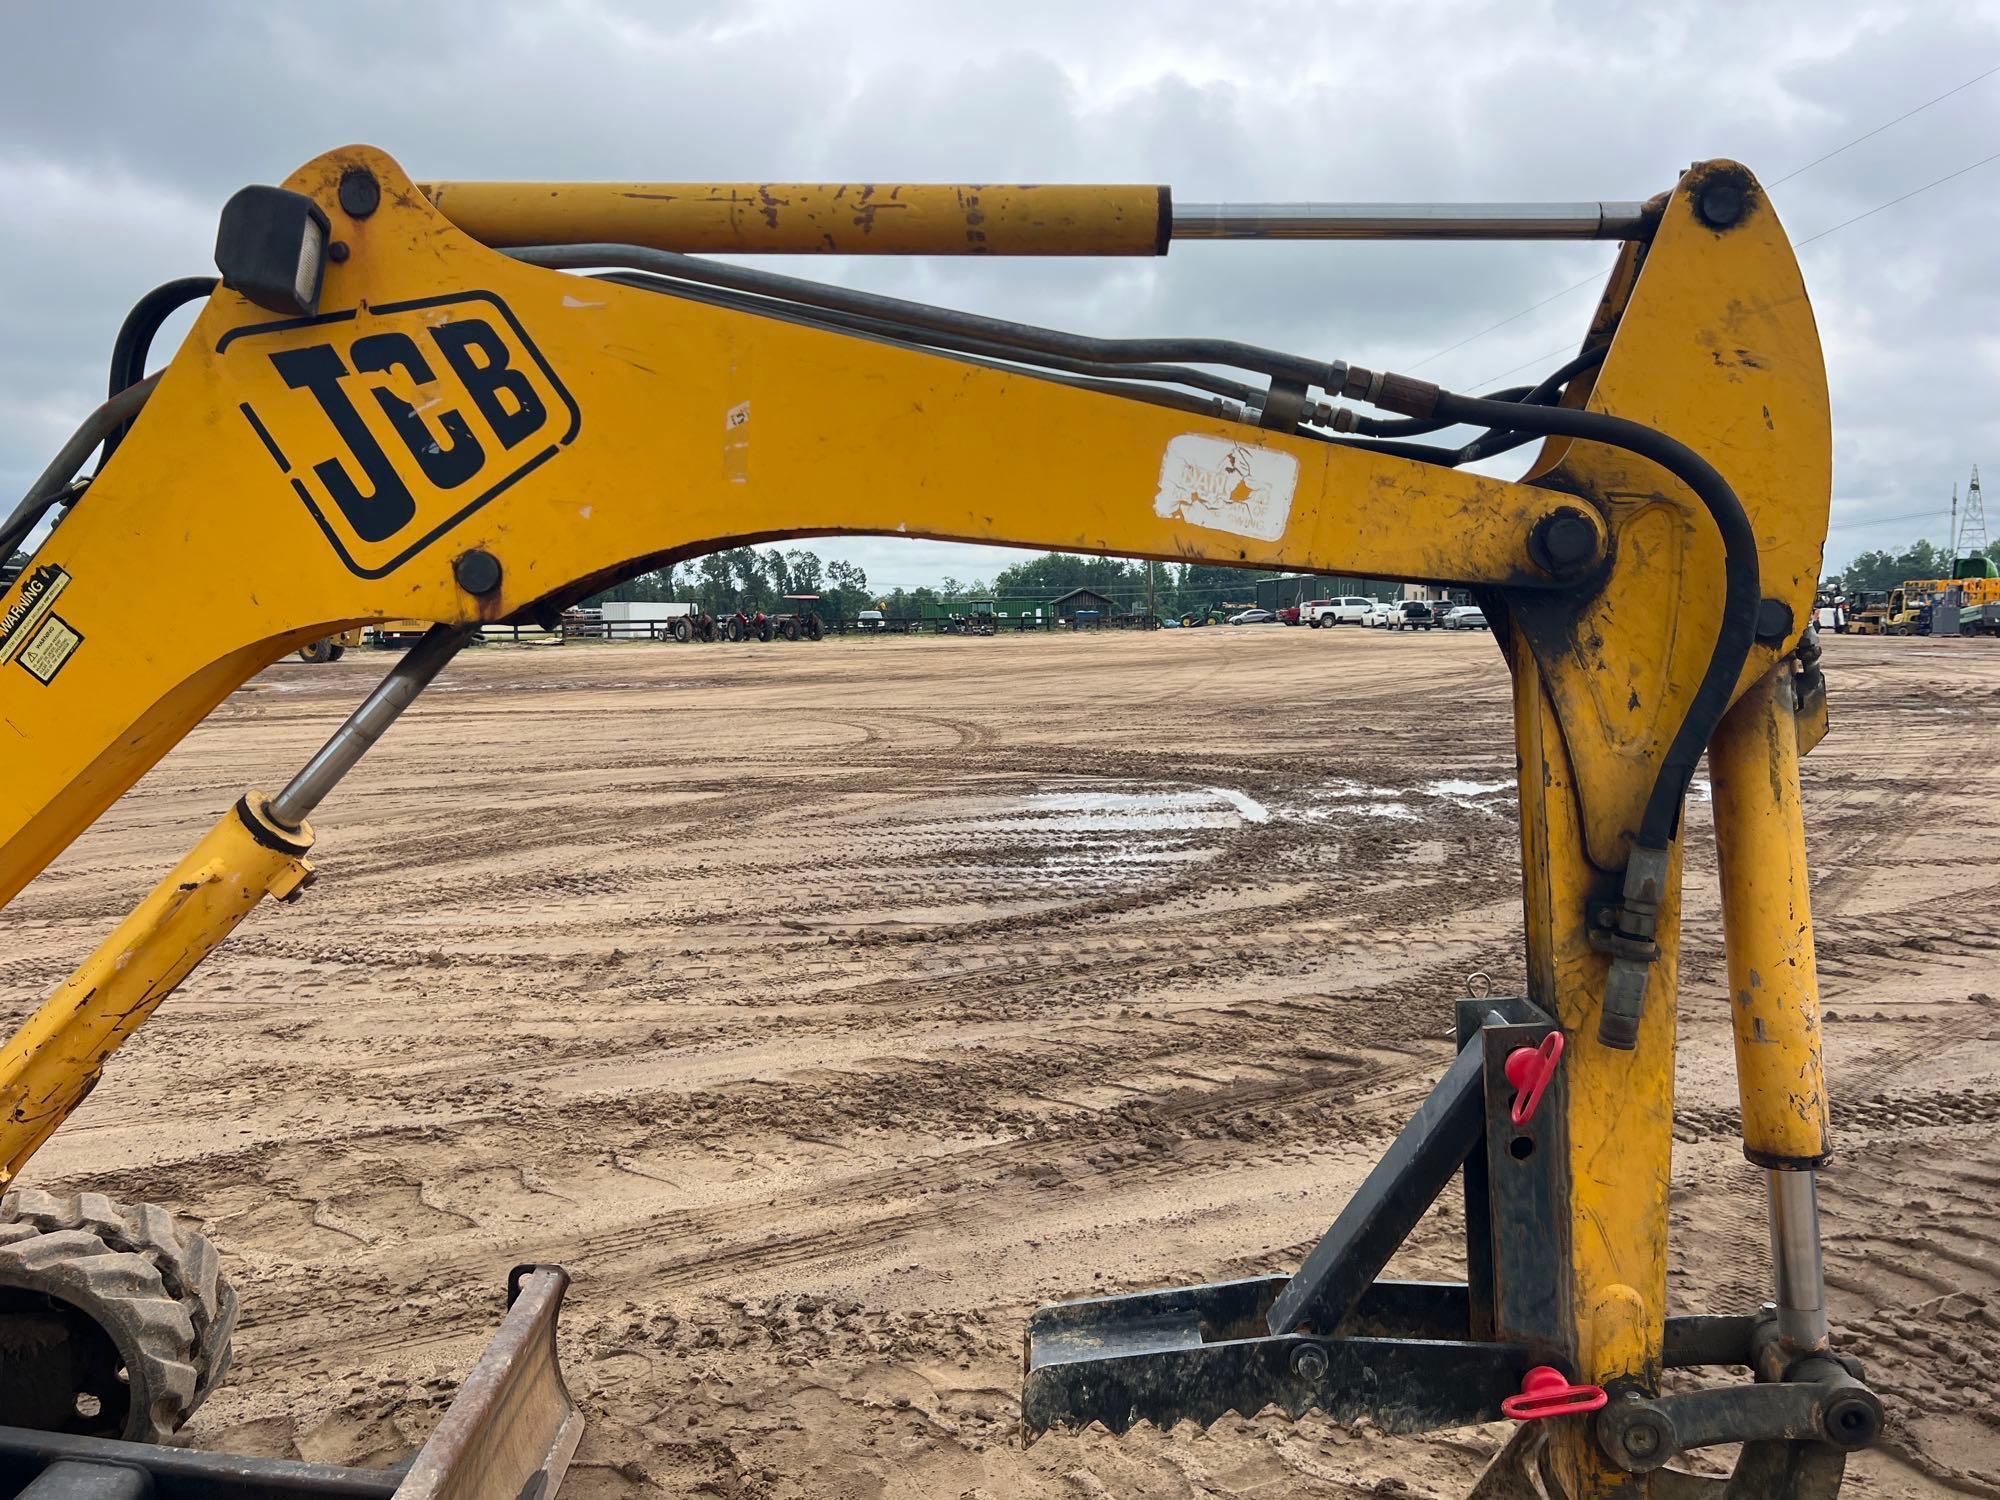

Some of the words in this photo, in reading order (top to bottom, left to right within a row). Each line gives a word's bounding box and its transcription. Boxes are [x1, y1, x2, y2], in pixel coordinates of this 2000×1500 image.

[268, 319, 547, 542] JCB
[0, 580, 44, 634] WARNING
[35, 626, 55, 649] WARNING
